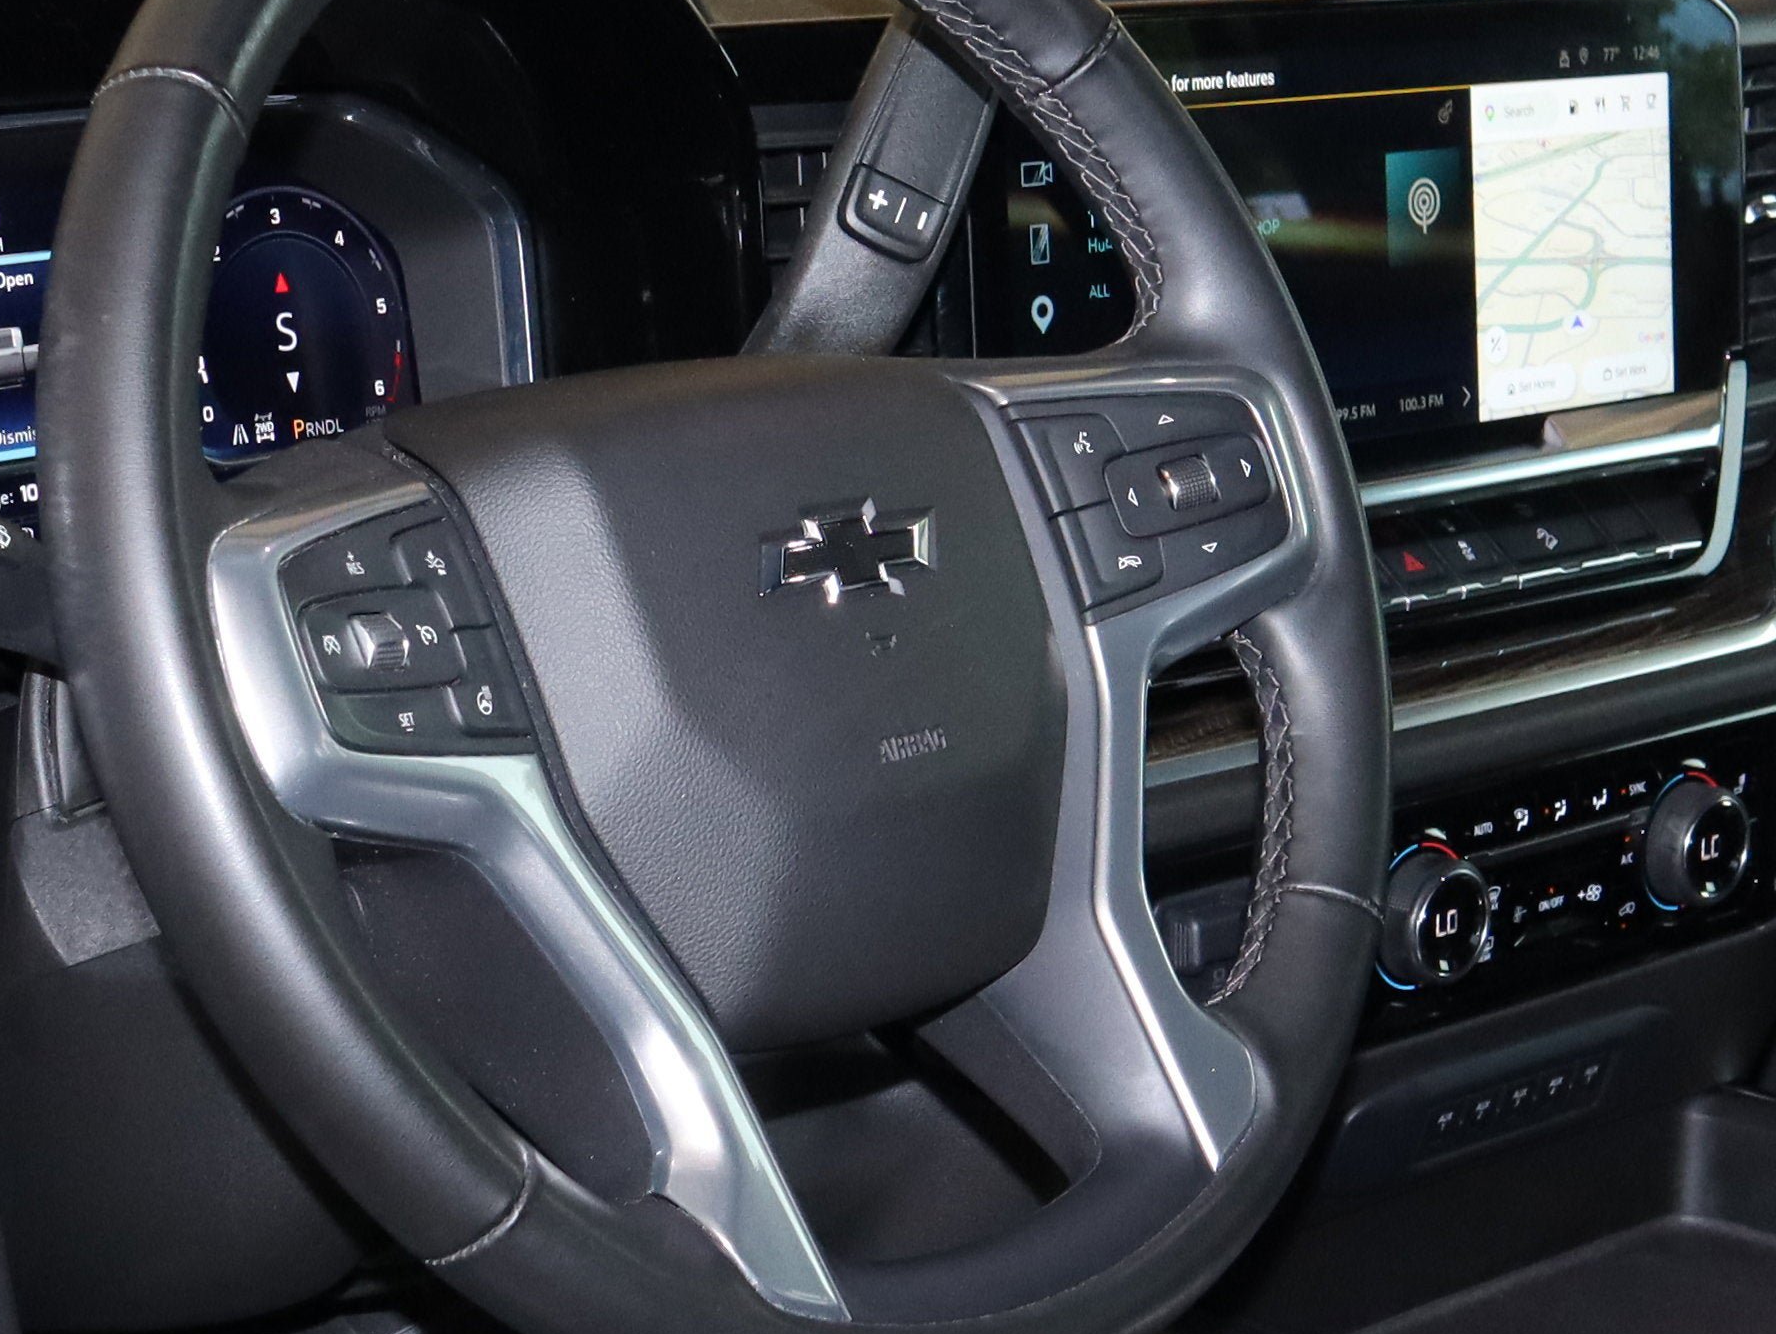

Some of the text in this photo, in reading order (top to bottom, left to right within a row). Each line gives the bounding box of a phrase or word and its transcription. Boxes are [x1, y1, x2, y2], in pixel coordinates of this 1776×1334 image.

[1170, 70, 1275, 92] for more features
[269, 207, 281, 225] 3
[334, 230, 345, 246] 4
[1089, 283, 1111, 299] ALL
[376, 298, 387, 314] 5
[275, 312, 298, 352] S
[374, 380, 385, 396] 6
[1360, 403, 1376, 418] FM
[1399, 393, 1444, 413] 100.3 FM
[293, 418, 345, 440] PRNDL
[398, 711, 416, 728] SET
[879, 726, 948, 764] AIRBAG
[1473, 821, 1493, 837] AUTO
[1538, 895, 1565, 912] ON/OFF
[1435, 909, 1458, 938] LO
